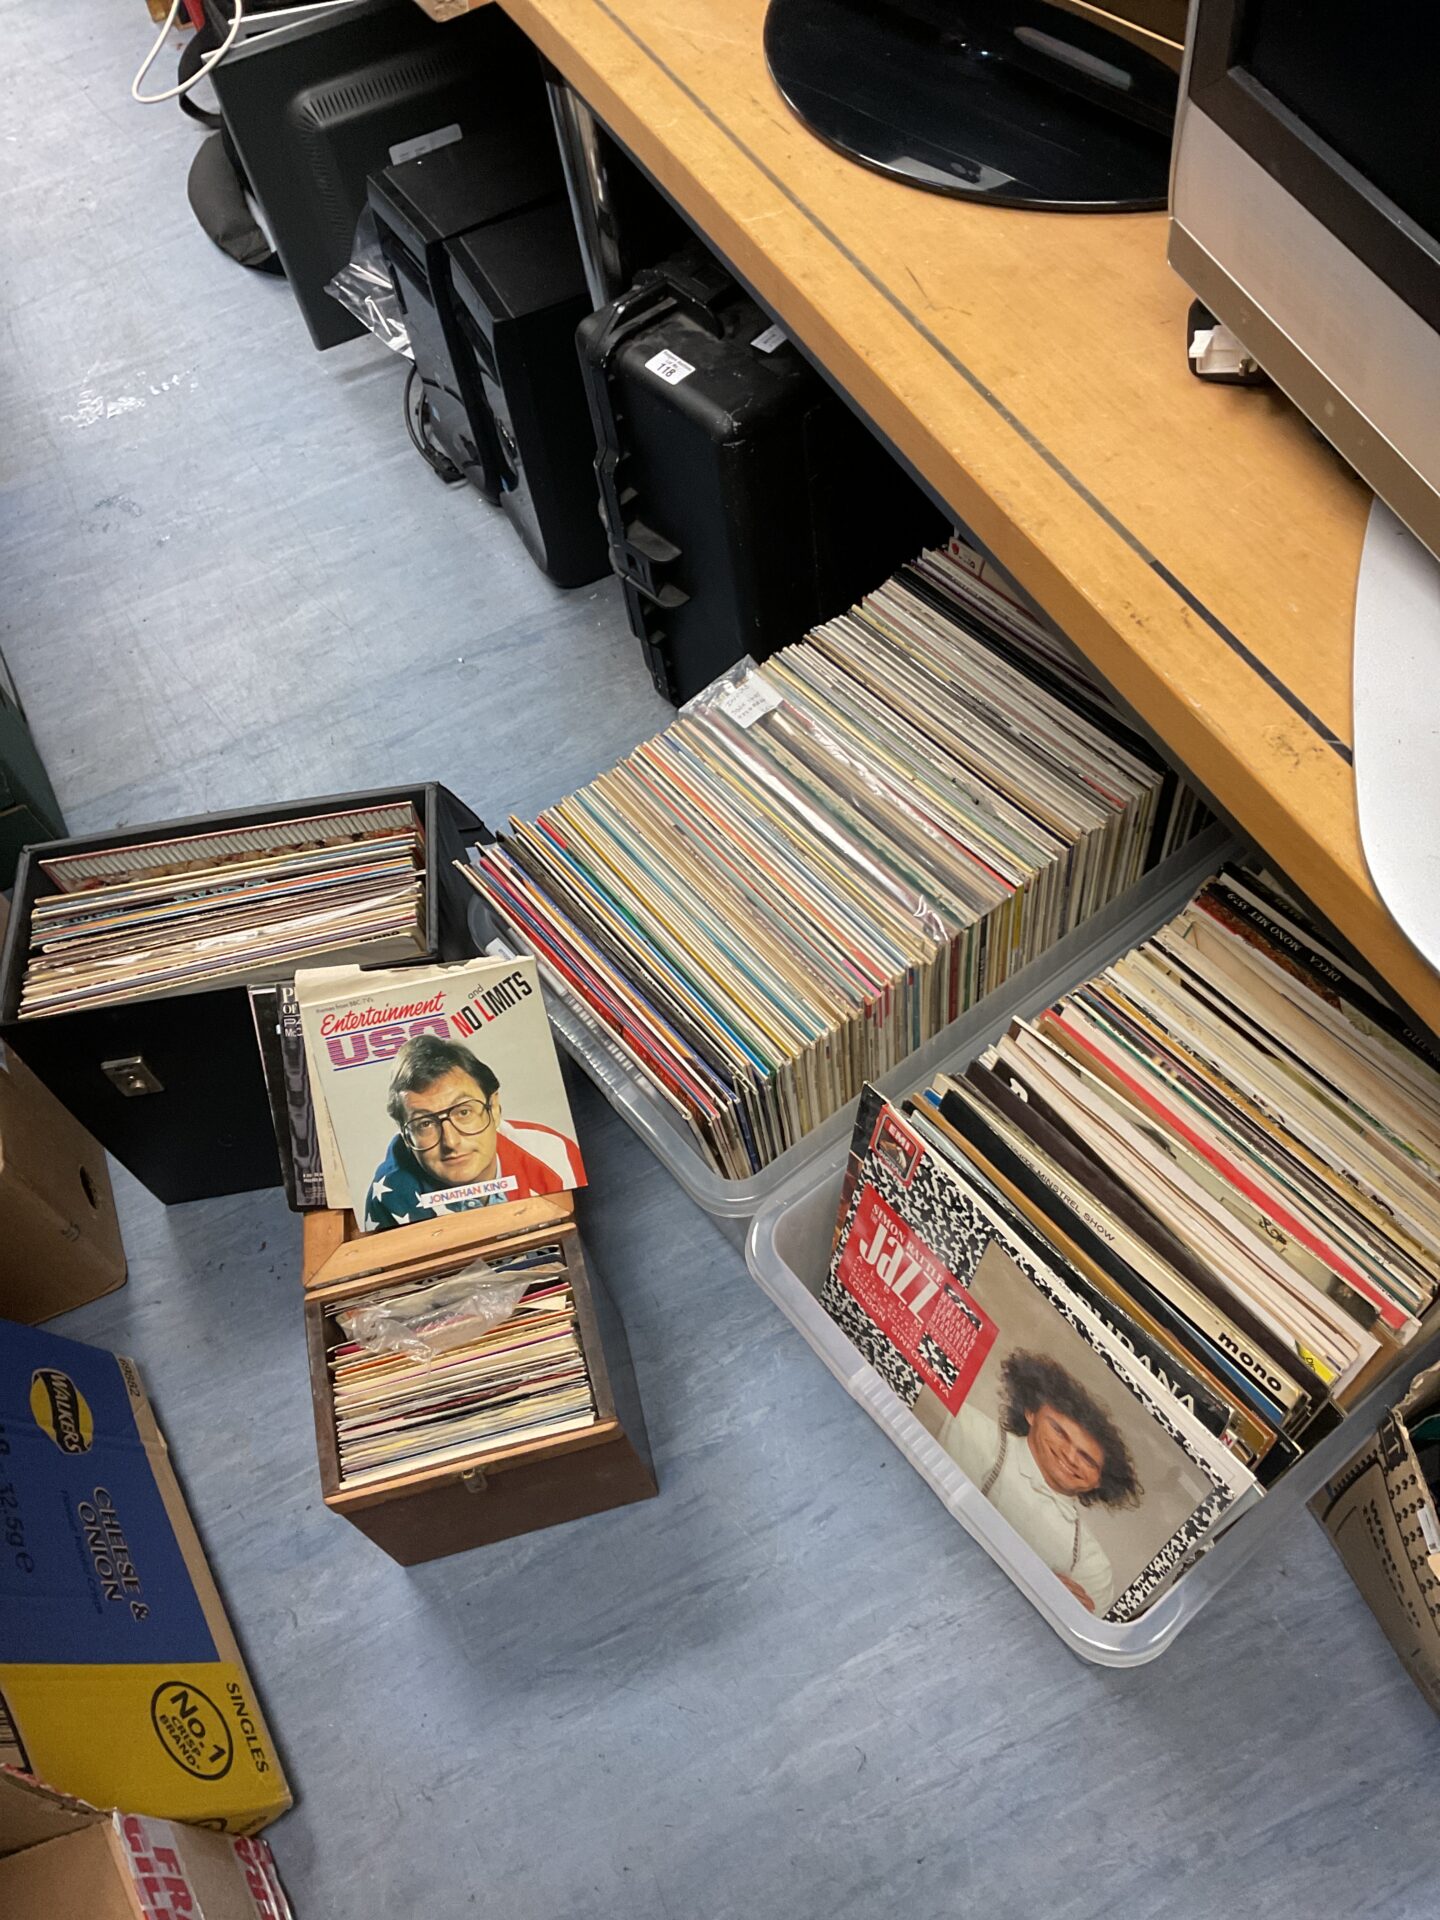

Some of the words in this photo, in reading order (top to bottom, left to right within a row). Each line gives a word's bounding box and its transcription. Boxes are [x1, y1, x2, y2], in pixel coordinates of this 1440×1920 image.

[656, 362, 677, 378] 118
[1269, 926, 1301, 951] MONO
[467, 984, 484, 1000] and
[1309, 954, 1342, 982] DECCA
[320, 991, 447, 1036] Entertainment
[450, 1005, 483, 1039] NO
[473, 970, 533, 1023] LIMITS
[888, 1123, 911, 1151] EMI
[430, 1186, 481, 1204] JONATHAN
[483, 1180, 508, 1194] KING
[1037, 1169, 1081, 1214] MINSTREL
[1082, 1212, 1116, 1242] SHOW
[872, 1204, 907, 1243] SIMON
[906, 1242, 944, 1286] RATTLE
[848, 1275, 887, 1322] LONDON
[890, 1325, 951, 1399] SINFONIETTA
[1217, 1332, 1283, 1392] mono
[50, 1373, 82, 1453] WALKERS
[78, 1501, 123, 1601] ONION
[93, 1486, 141, 1594] CHEESE
[130, 1600, 150, 1622] &
[171, 1715, 201, 1757] CRISP
[208, 1744, 228, 1764] 1
[226, 1682, 270, 1774] SINGLES
